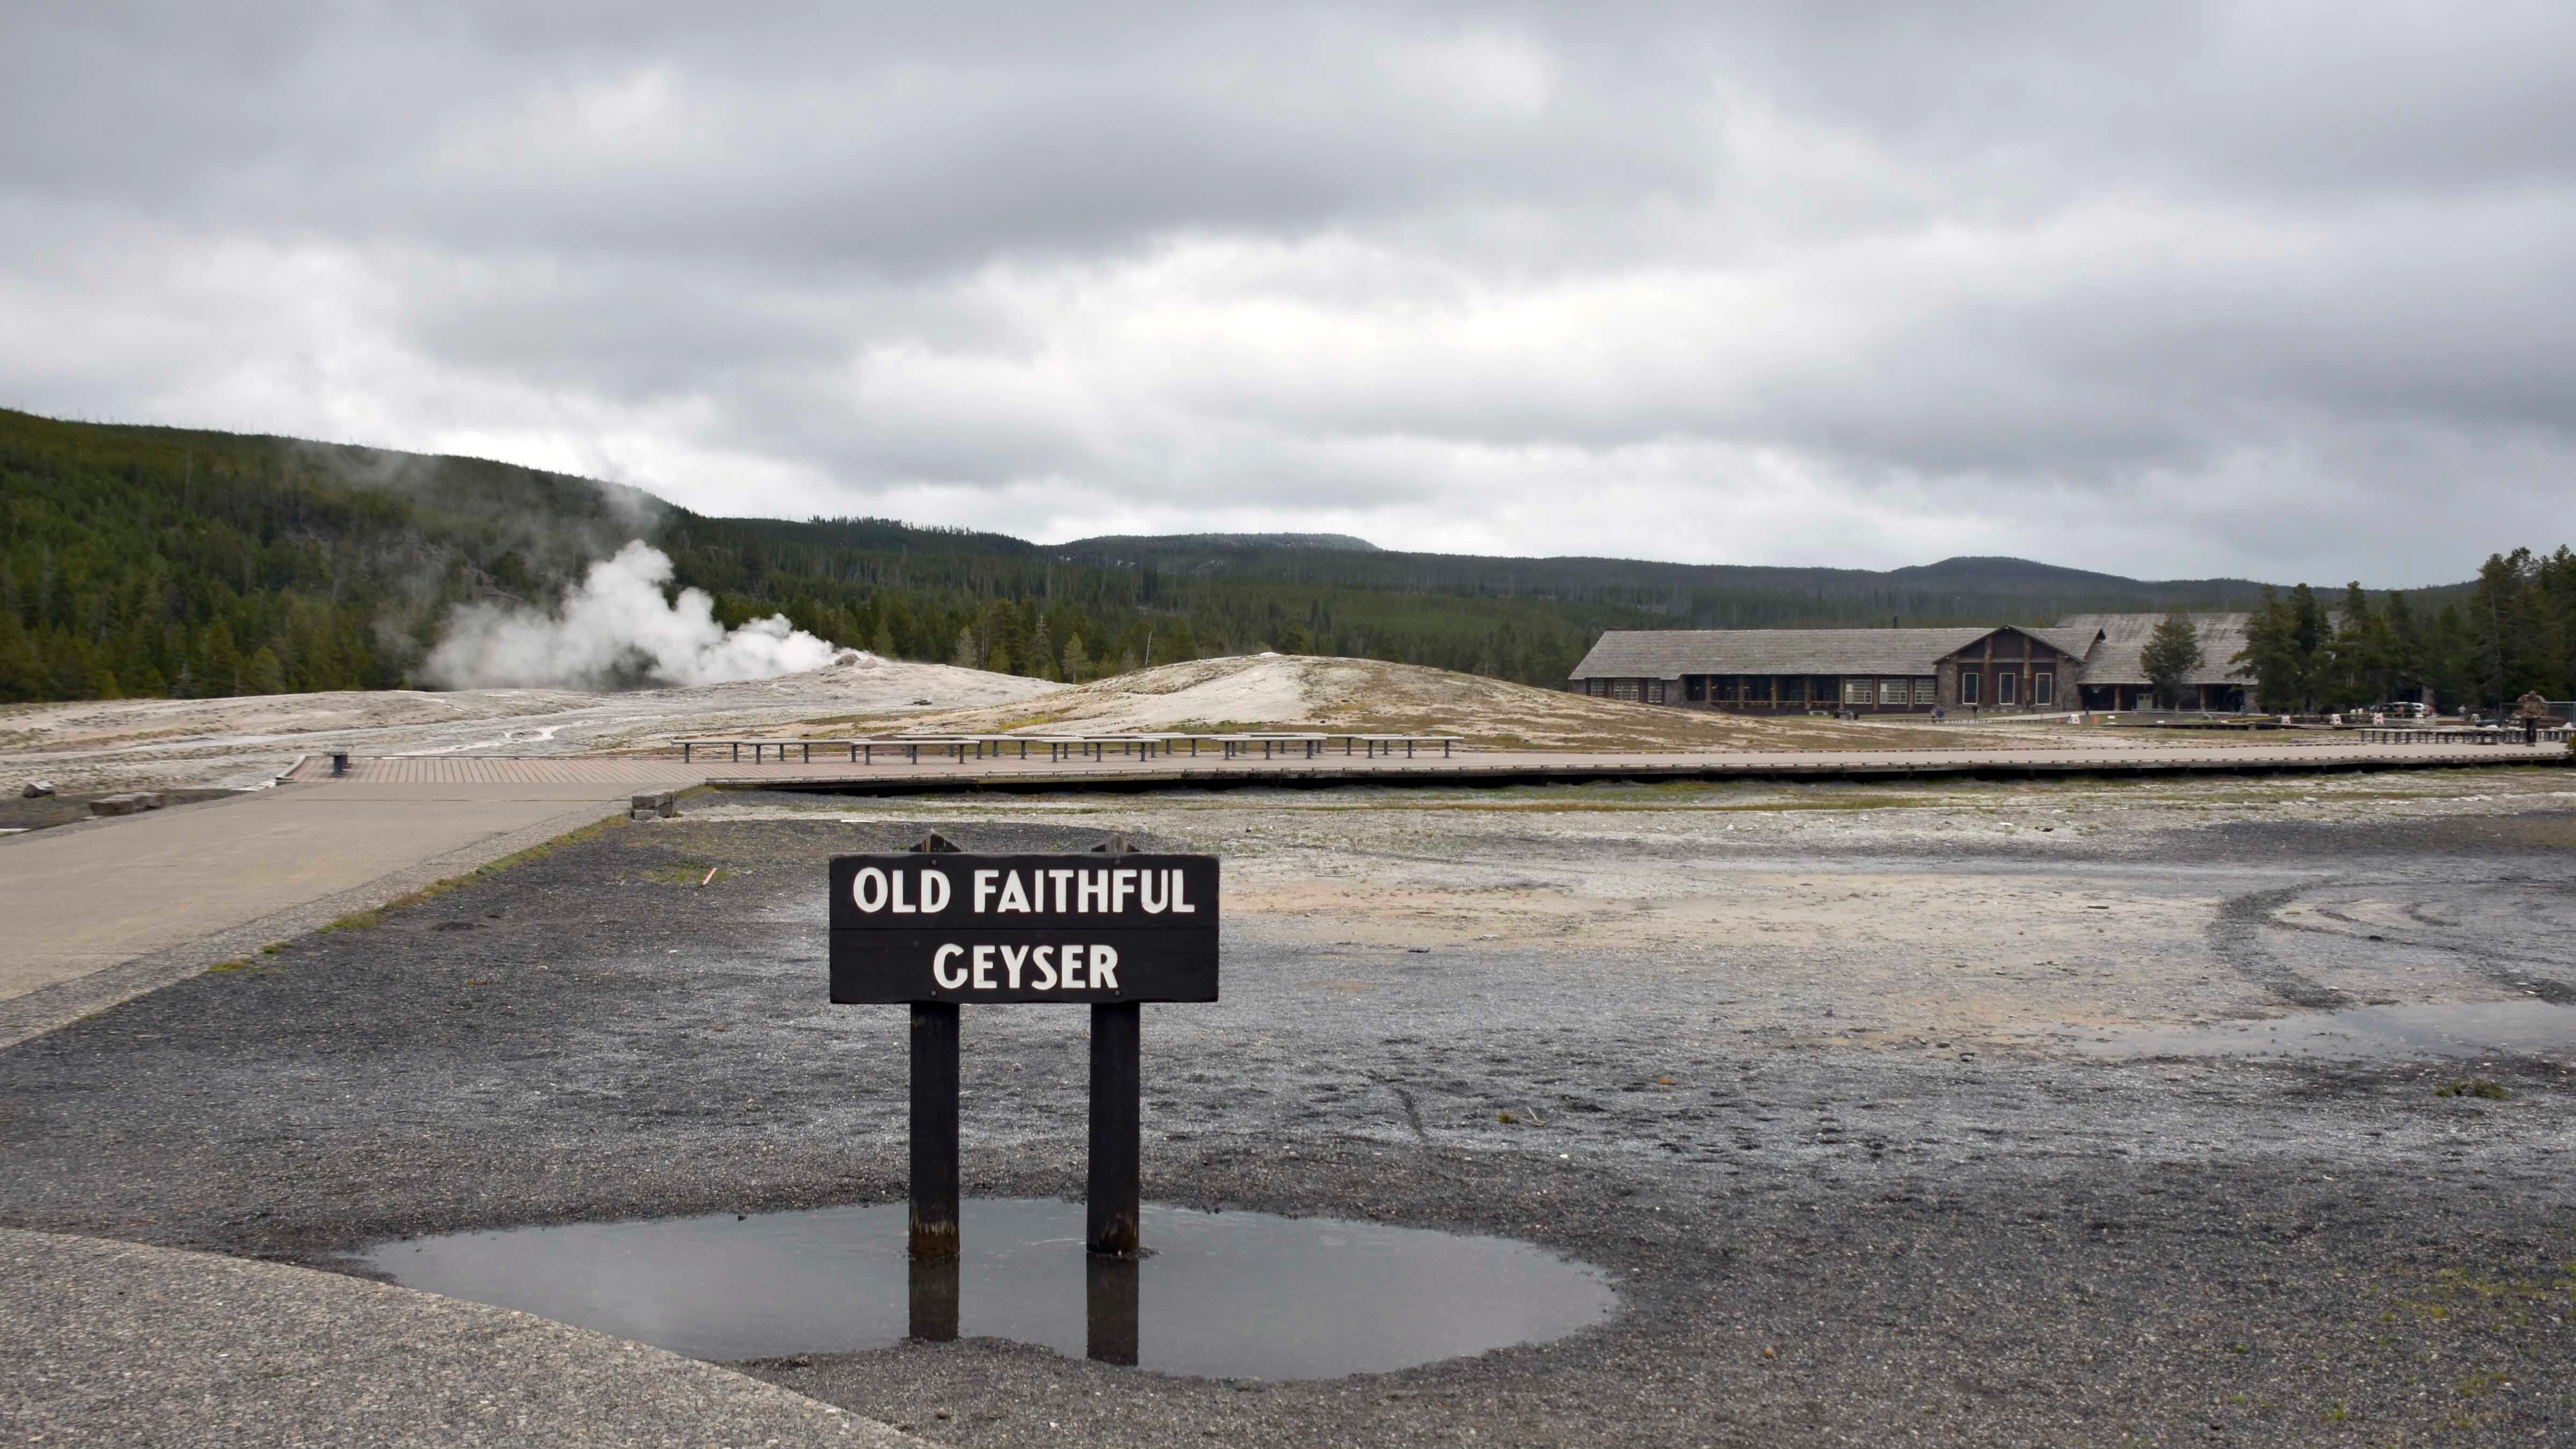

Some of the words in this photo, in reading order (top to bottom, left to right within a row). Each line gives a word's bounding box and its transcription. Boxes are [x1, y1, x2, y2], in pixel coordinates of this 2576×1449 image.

[853, 867, 951, 913] OLD
[974, 869, 1196, 914] FAITHFUL
[933, 943, 1119, 990] GEYSER
